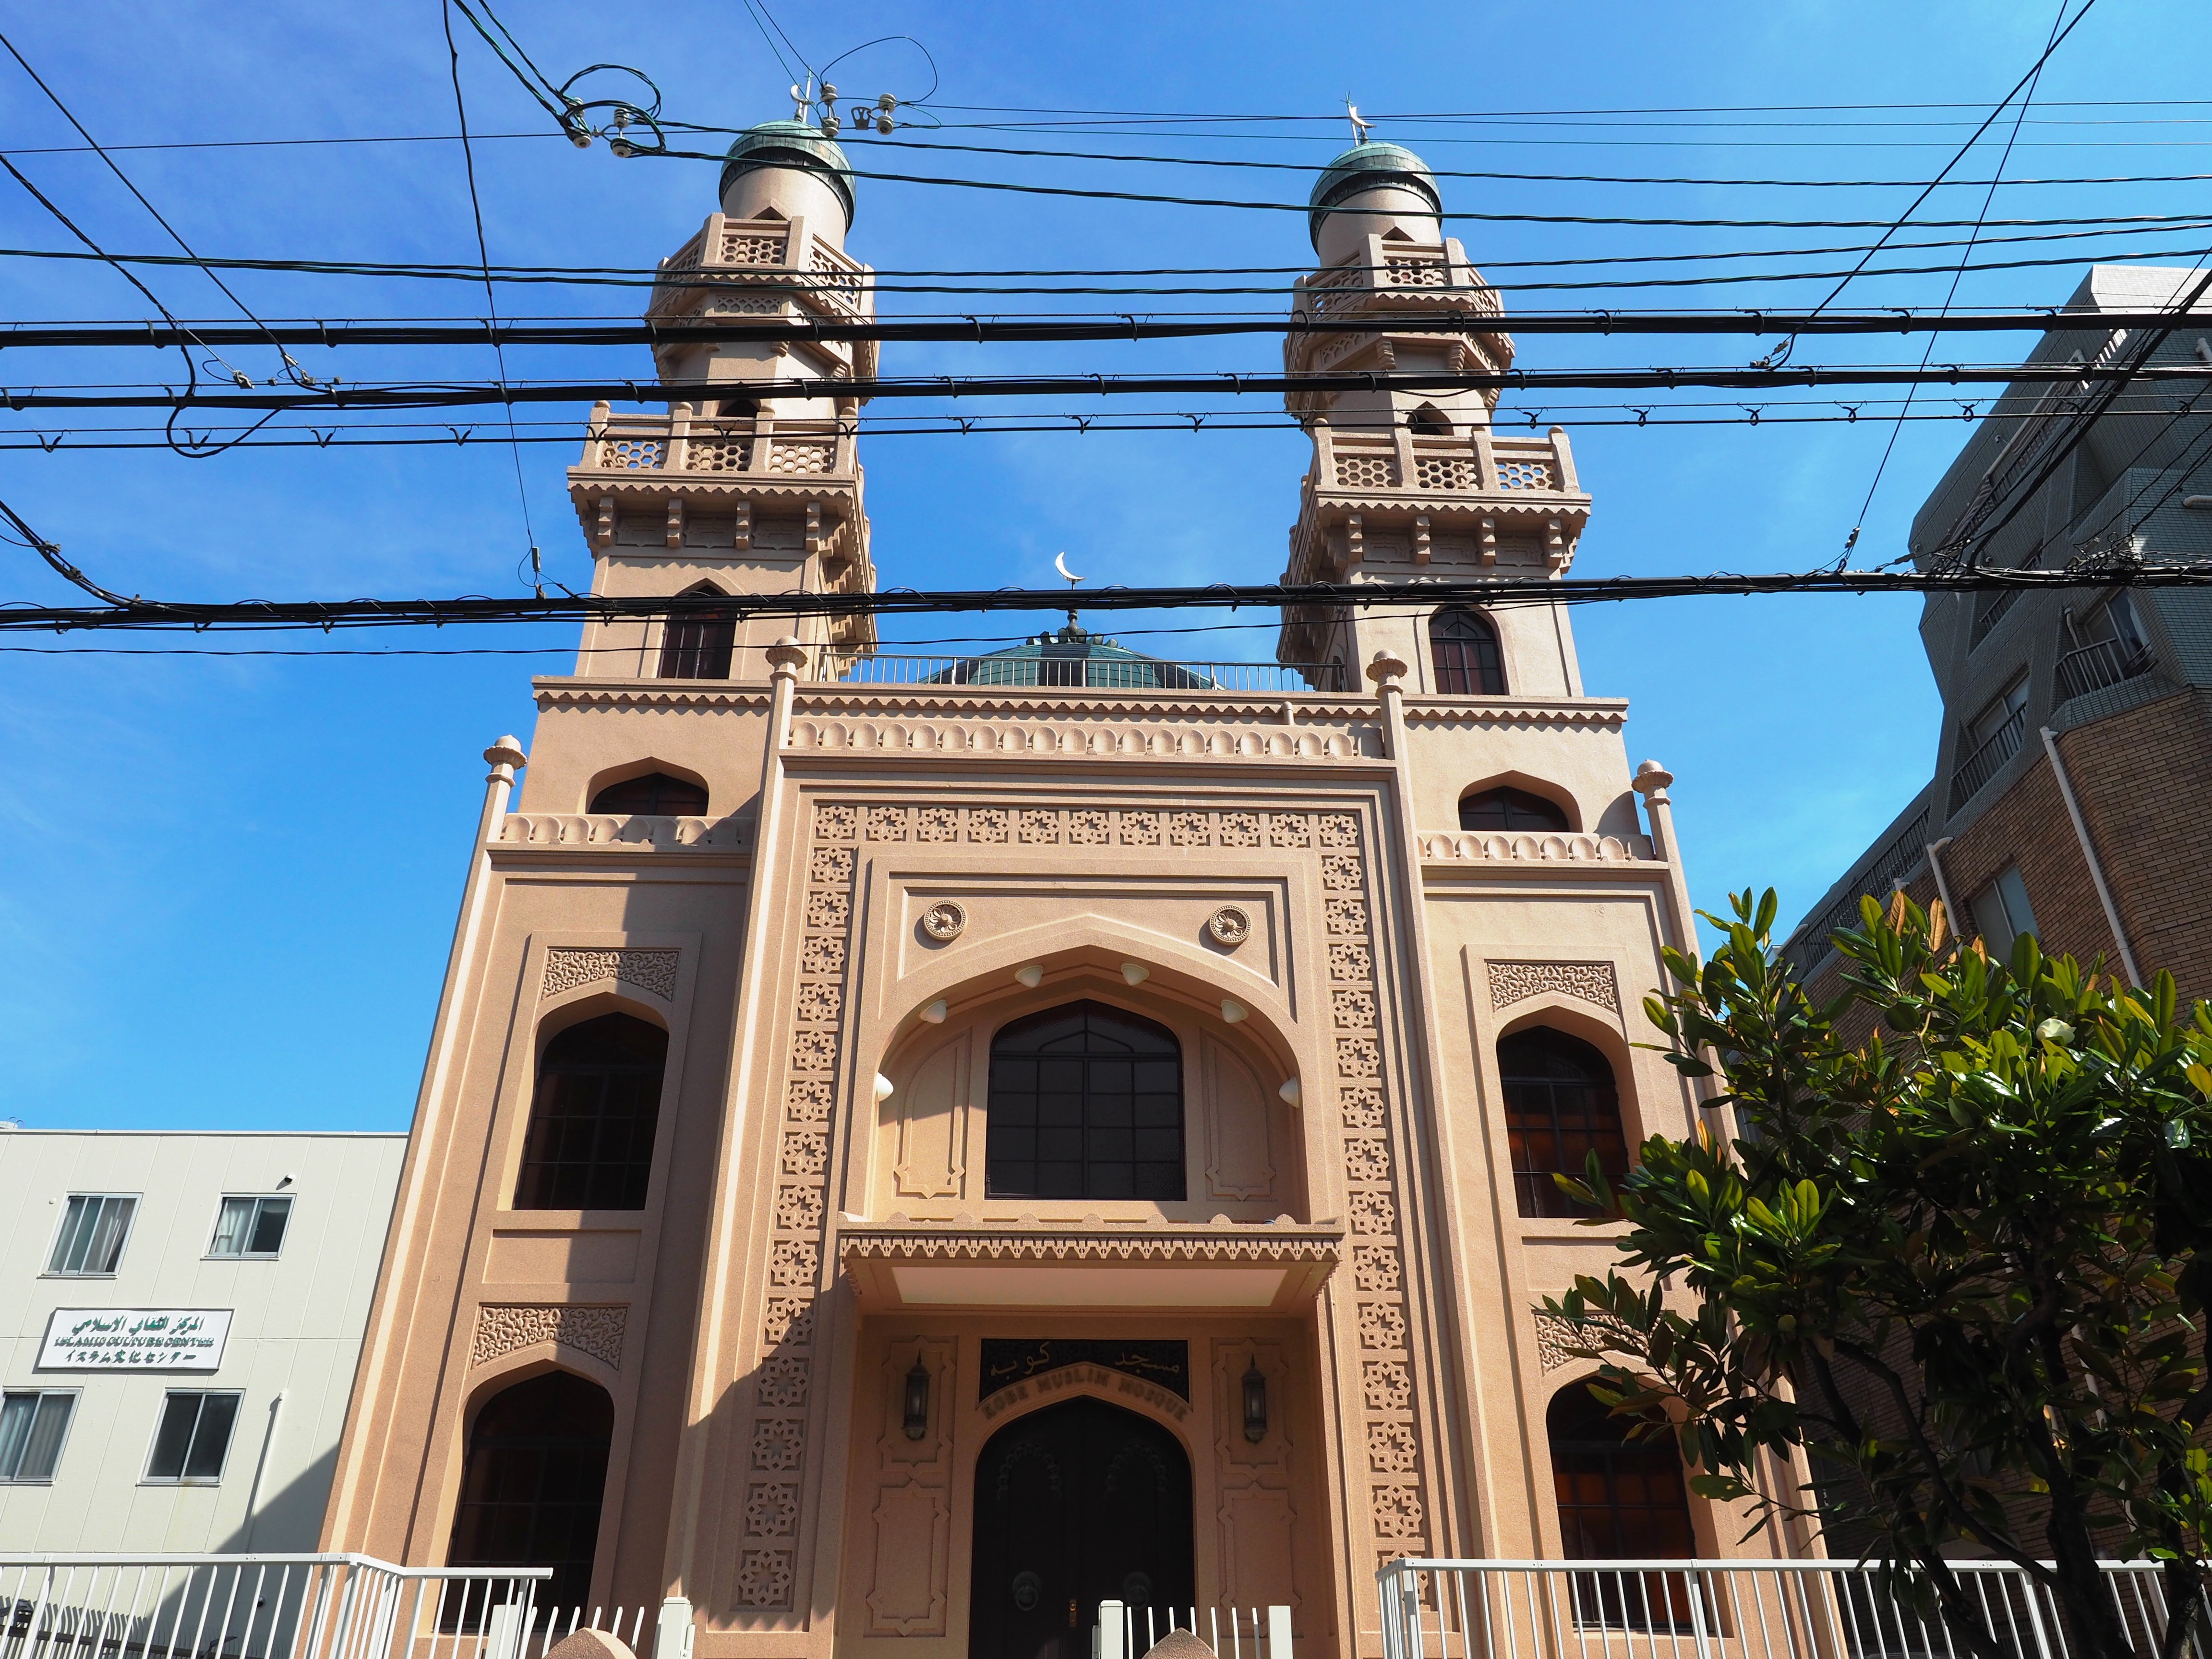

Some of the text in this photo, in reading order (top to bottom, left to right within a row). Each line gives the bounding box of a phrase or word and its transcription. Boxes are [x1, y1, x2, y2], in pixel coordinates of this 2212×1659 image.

[53, 1337, 215, 1347] ISLAMIC CULTURE CENTER
[65, 1349, 196, 1364] イスラム文化センター
[1115, 1352, 1179, 1373] مسجد
[982, 1367, 1187, 1422] KOBE MUSLIM MOSQUE
